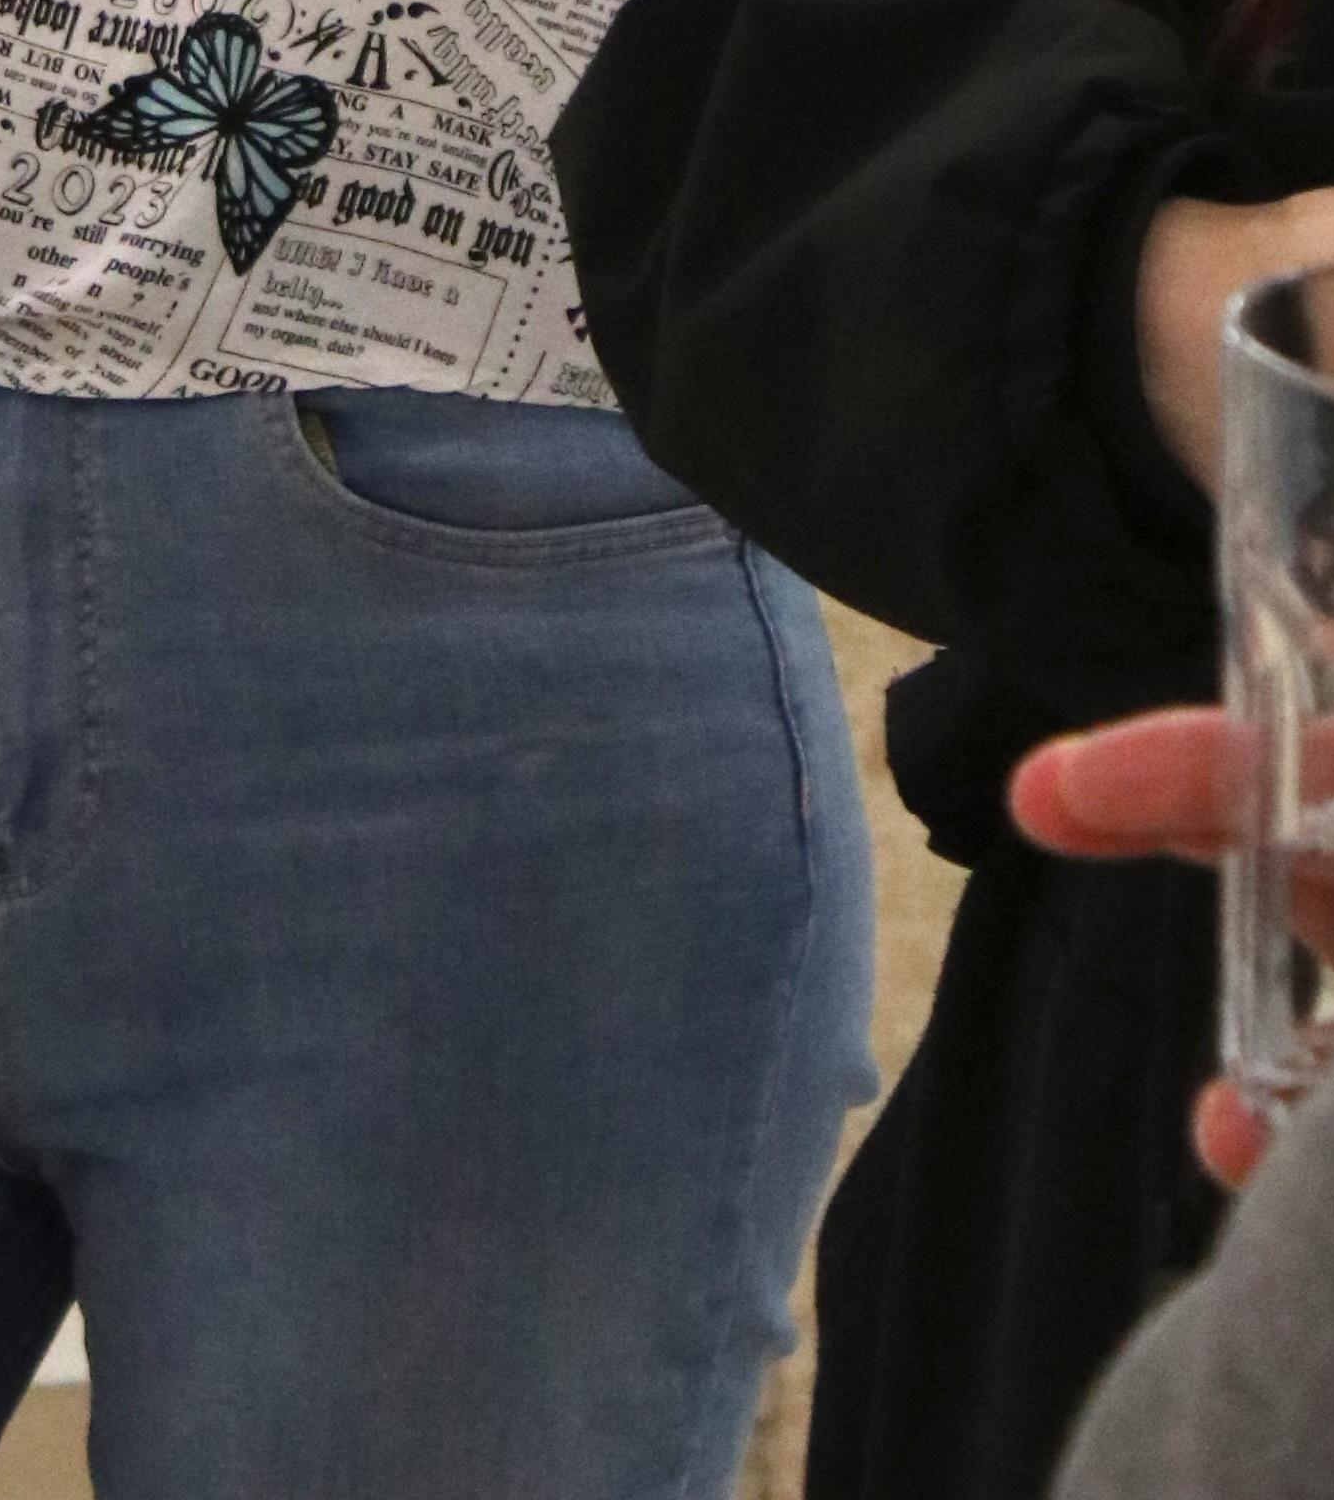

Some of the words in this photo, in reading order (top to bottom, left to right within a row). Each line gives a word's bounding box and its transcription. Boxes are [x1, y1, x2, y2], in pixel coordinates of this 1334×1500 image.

[20, 50, 65, 74] BUT
[74, 63, 107, 86] NO
[389, 104, 404, 120] A
[432, 114, 495, 148] MASK
[367, 144, 419, 170] STAY
[427, 159, 483, 188] SAFE
[331, 178, 416, 227] good
[422, 202, 465, 247] on
[468, 218, 535, 268] you
[27, 244, 78, 271] other
[102, 257, 192, 290] people's
[72, 224, 109, 245] still
[120, 231, 205, 268] worrying
[243, 322, 267, 339] my
[251, 303, 279, 317] and
[284, 308, 326, 327] where
[330, 317, 359, 334] else
[362, 327, 411, 350] should
[423, 343, 457, 365] keep
